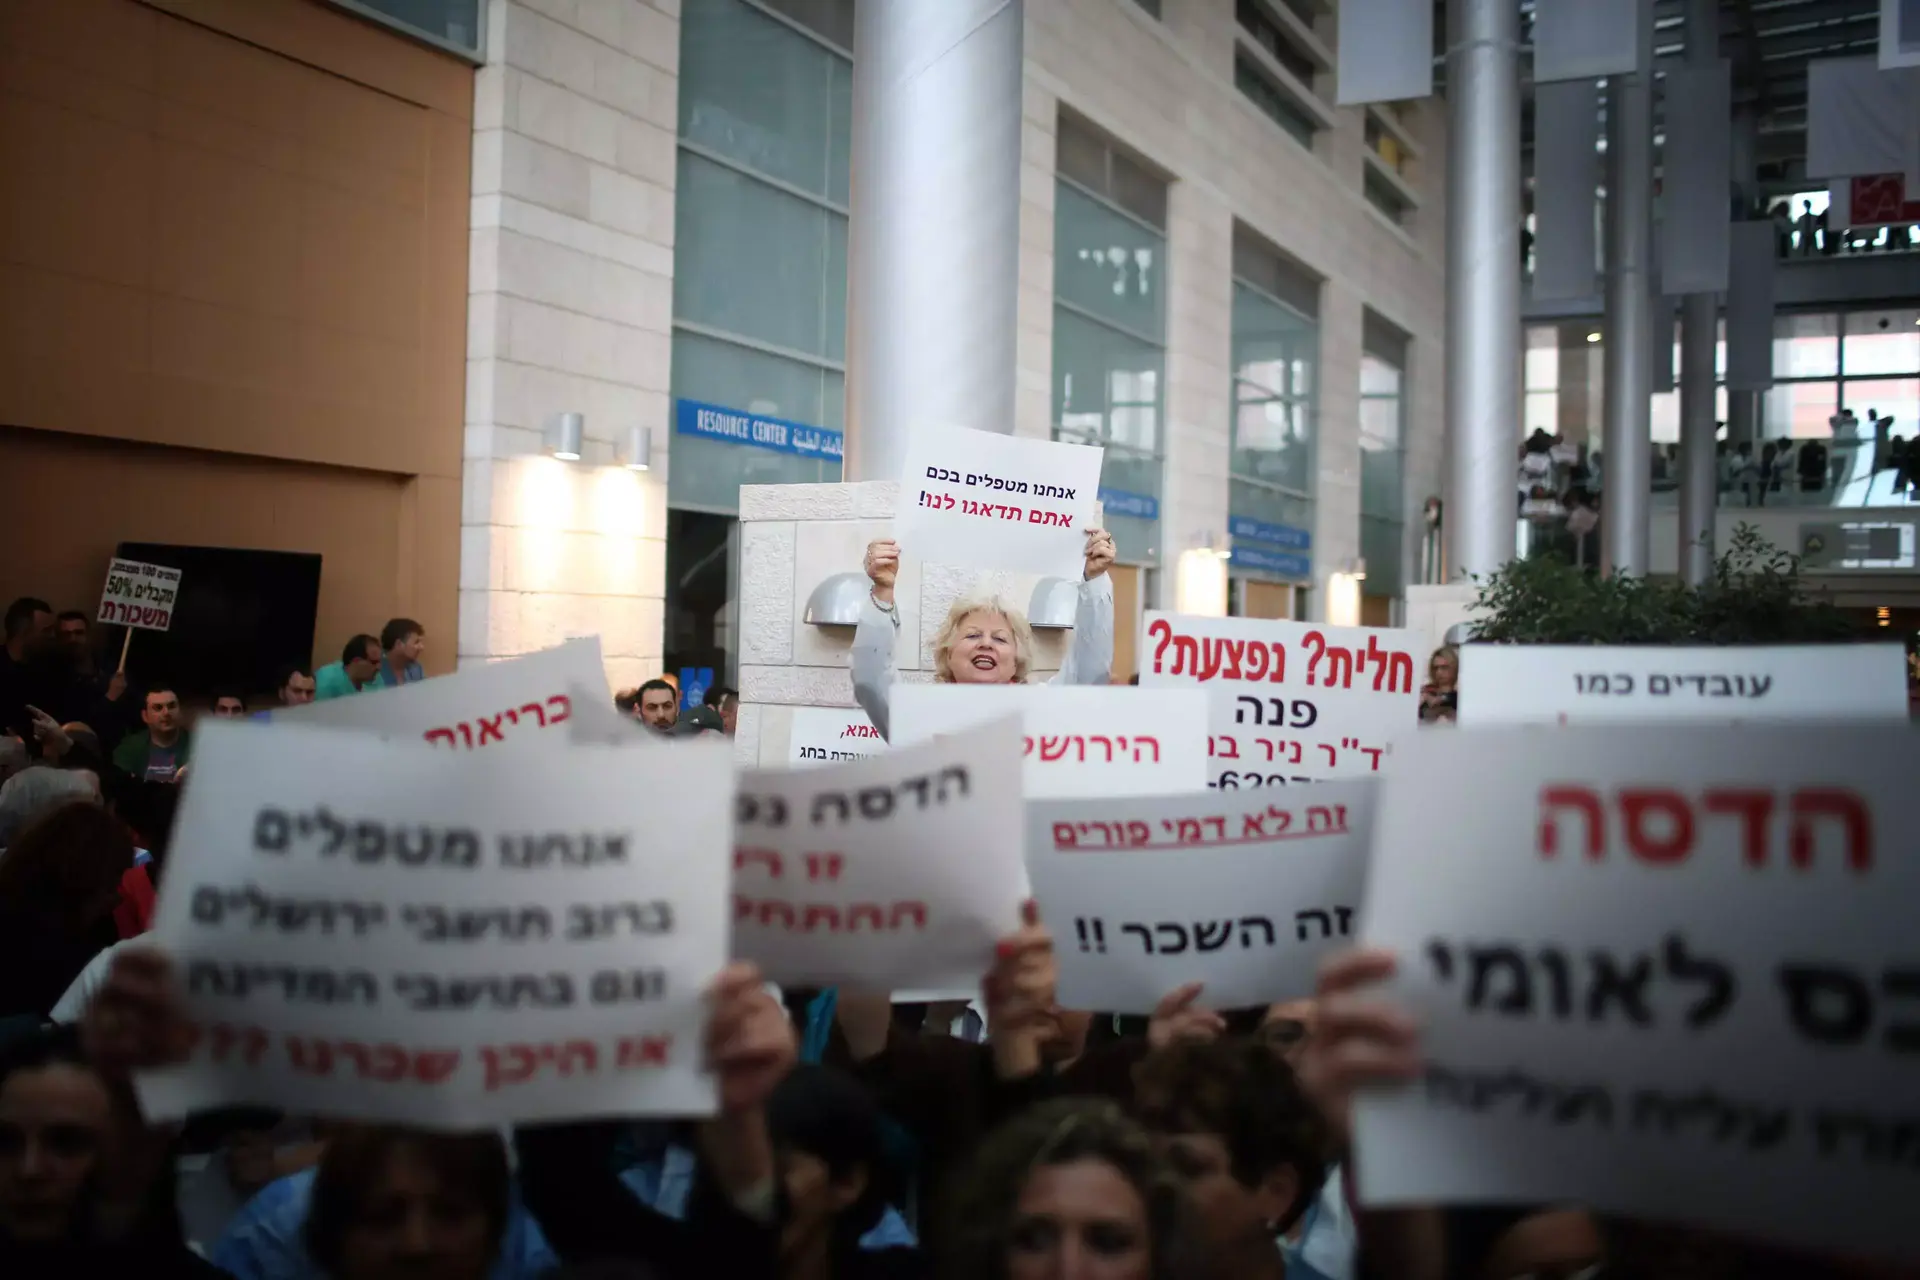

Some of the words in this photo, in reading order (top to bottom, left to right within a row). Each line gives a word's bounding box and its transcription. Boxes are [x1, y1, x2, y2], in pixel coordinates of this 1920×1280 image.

[697, 409, 749, 439] RESOURCE
[752, 420, 789, 446] CENTER
[926, 466, 960, 483] בכם
[965, 473, 1028, 493] מטפלים
[918, 490, 956, 511] לנו!
[1033, 483, 1076, 500] אנחנו
[962, 499, 1022, 521] תדאגו
[1029, 509, 1073, 528] אתם
[107, 575, 133, 598] 50%
[135, 582, 174, 606] מקבלים
[101, 601, 169, 627] משכורת
[1148, 619, 1286, 683] נפצעת?
[1300, 630, 1414, 694] חלית?
[1575, 672, 1635, 697] כמו
[1647, 672, 1773, 699] עובדים
[1236, 695, 1318, 729] פנה
[840, 724, 880, 739] אמא,
[799, 746, 827, 760] בחג
[1255, 738, 1302, 764] ניר
[1317, 737, 1384, 771] ד"ר
[811, 764, 972, 824] הדסה
[1053, 821, 1151, 846] פורים
[1162, 815, 1226, 842] דמי
[1243, 805, 1292, 836] לא
[1306, 805, 1349, 832] זה
[1537, 784, 1873, 872] הדסה
[254, 805, 481, 870] מטפלים
[499, 830, 634, 869] אנחנו
[191, 884, 386, 938] ירושלים
[402, 902, 553, 942] תושבי
[566, 900, 675, 940] ברוב
[1295, 905, 1353, 942] זה
[1121, 914, 1276, 954] השכר
[1425, 932, 1738, 1030] לאומי
[286, 1034, 461, 1083] שכרנו
[478, 1035, 599, 1089] היכן
